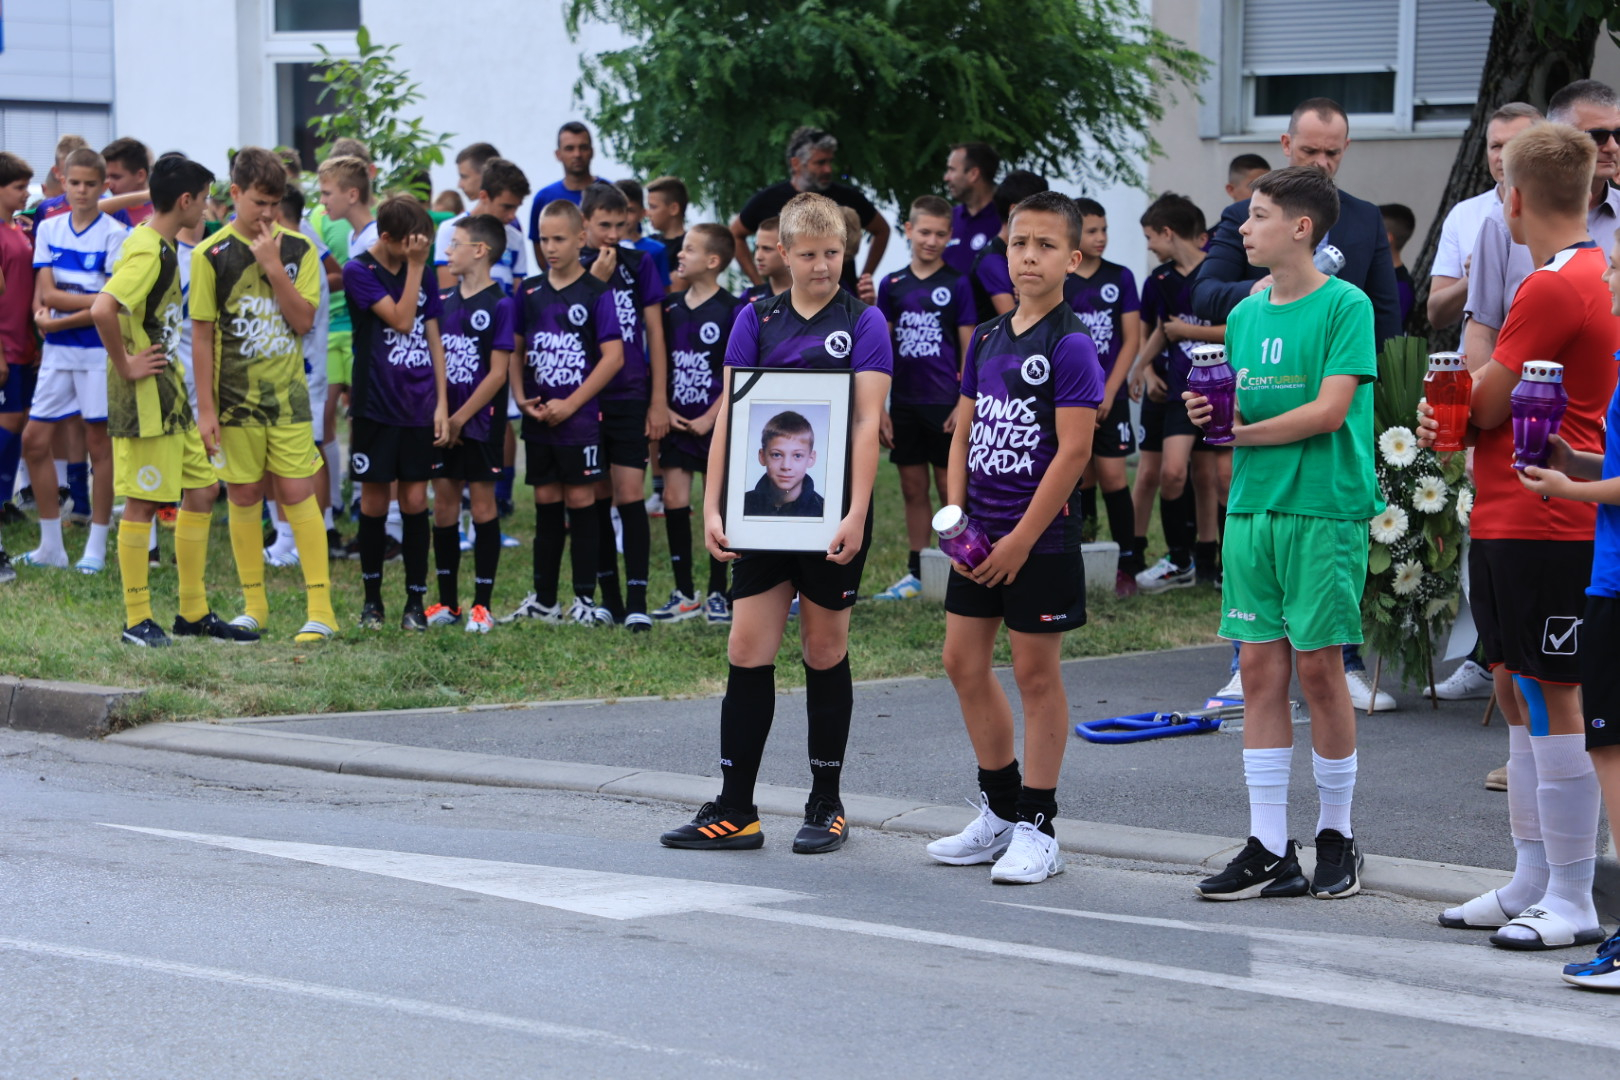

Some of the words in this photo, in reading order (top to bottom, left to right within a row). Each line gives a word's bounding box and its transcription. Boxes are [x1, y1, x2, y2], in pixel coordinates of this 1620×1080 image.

[900, 311, 942, 328] PONOS
[533, 331, 583, 351] PONOS
[895, 326, 943, 342] DONJEG
[527, 349, 586, 369] DONJEG
[899, 340, 941, 358] GRADA
[1261, 337, 1283, 365] 10
[534, 366, 584, 388] GRADA
[672, 383, 709, 406] RADA
[1117, 422, 1130, 443] 16
[583, 445, 598, 468] 17
[968, 444, 1035, 476] GRADA
[810, 759, 840, 767] alpas
